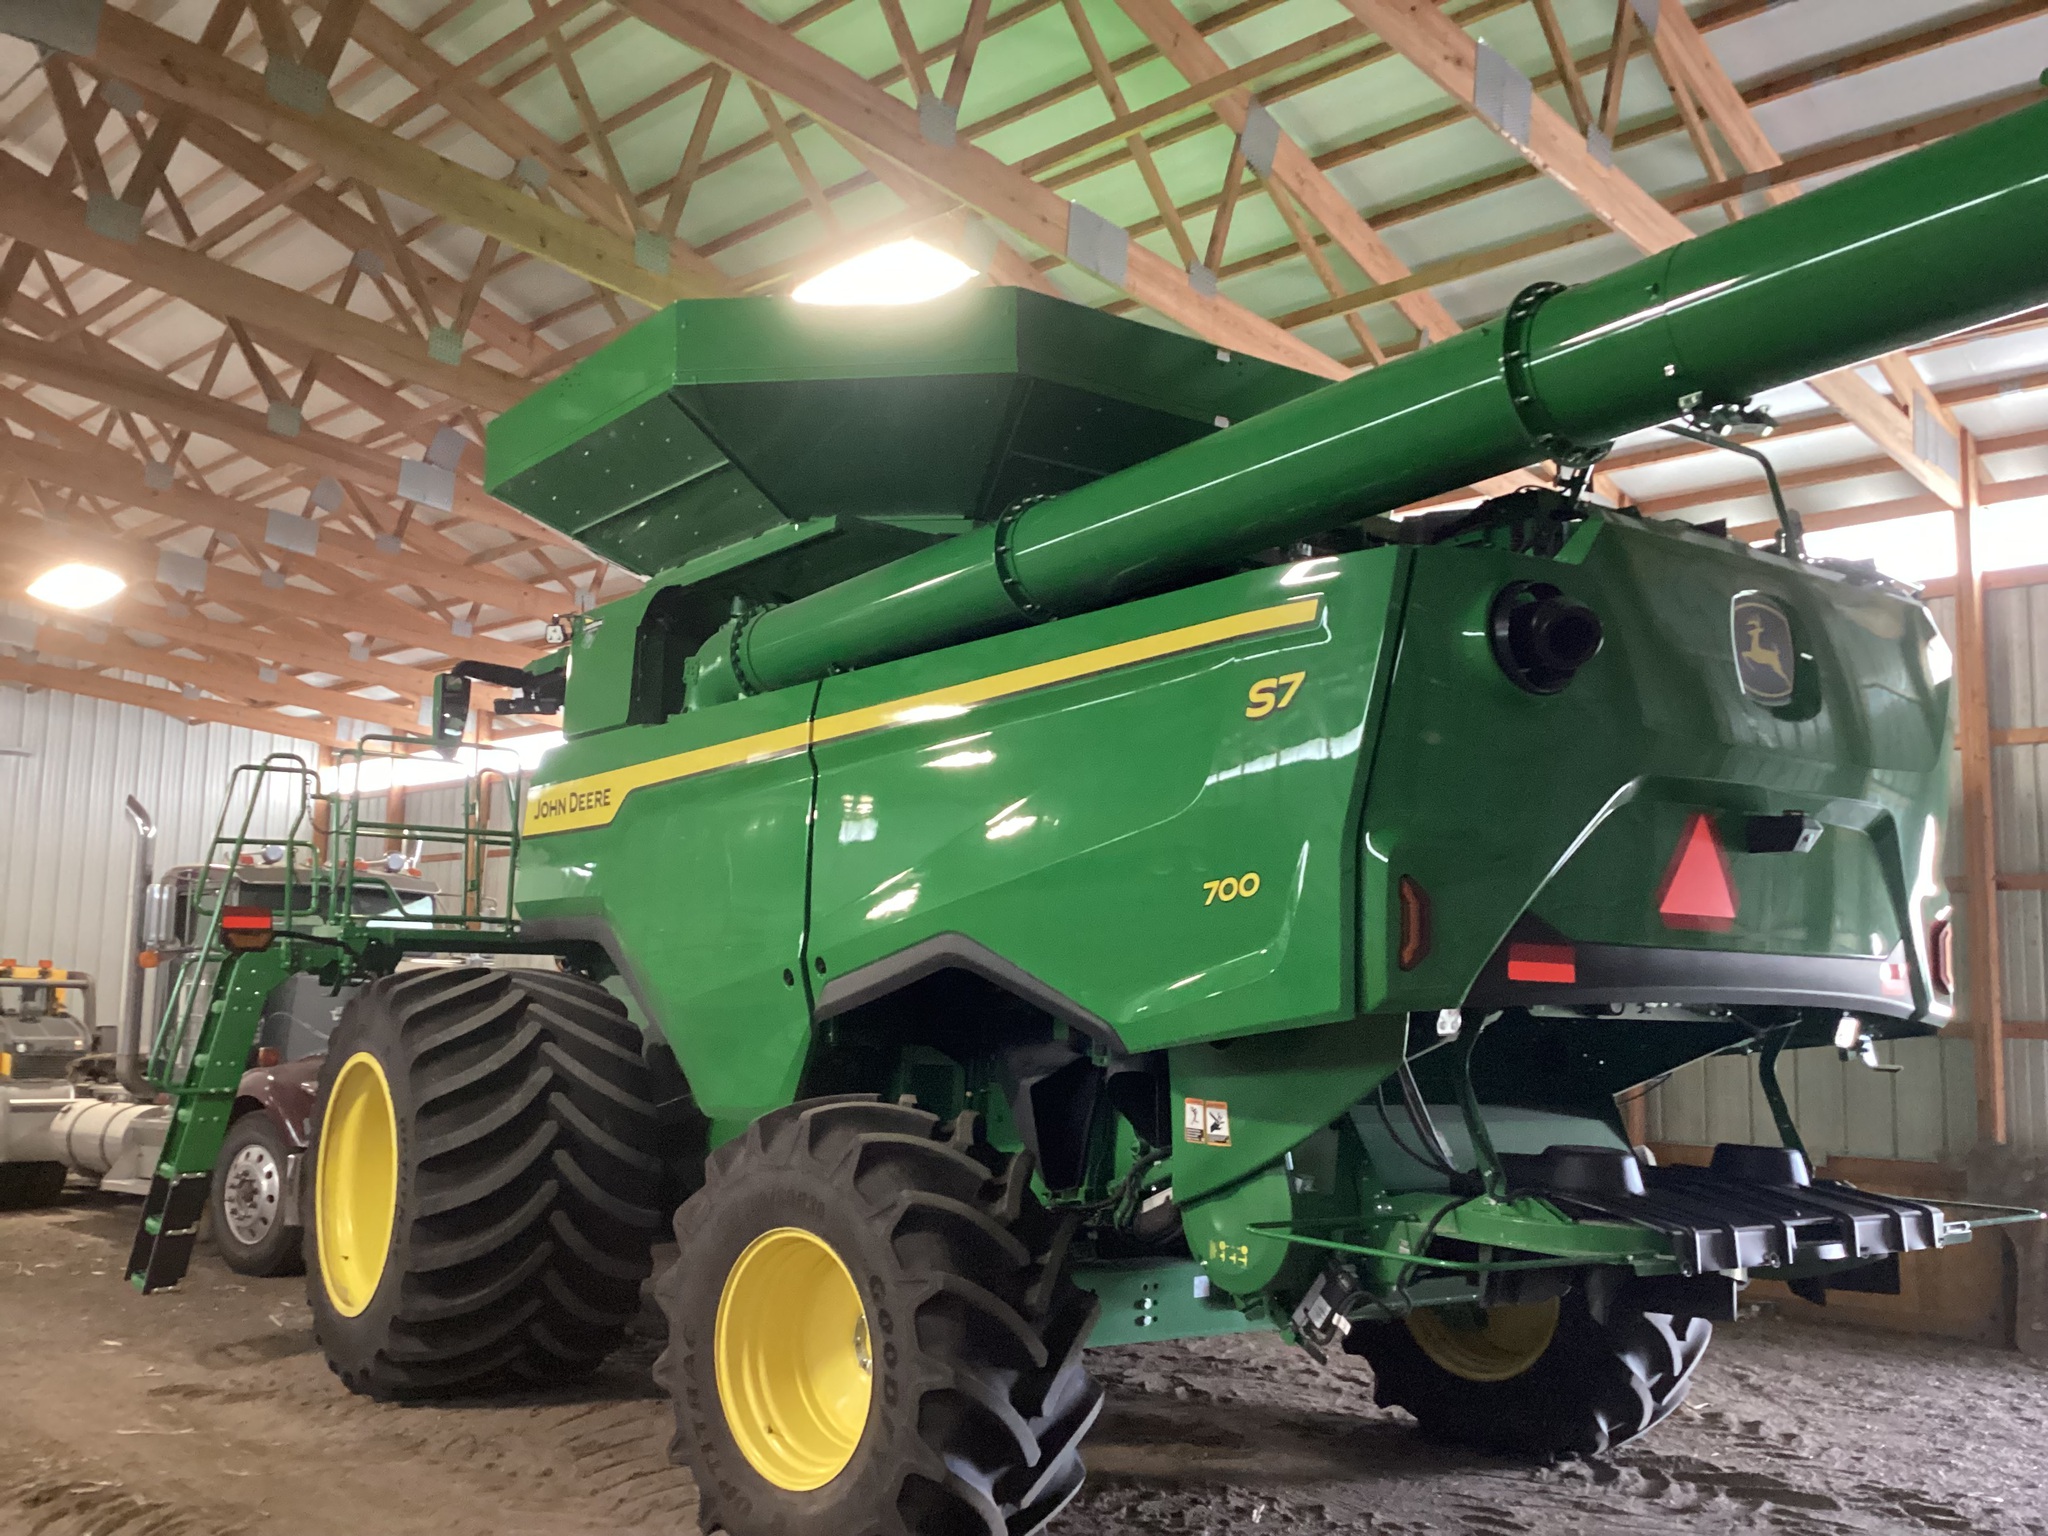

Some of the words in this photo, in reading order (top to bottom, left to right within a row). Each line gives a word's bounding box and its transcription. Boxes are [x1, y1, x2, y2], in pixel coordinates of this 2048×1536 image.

[1245, 671, 1306, 719] S7
[533, 797, 566, 820] JOHN
[569, 788, 611, 813] DEERE
[1202, 872, 1261, 906] 700
